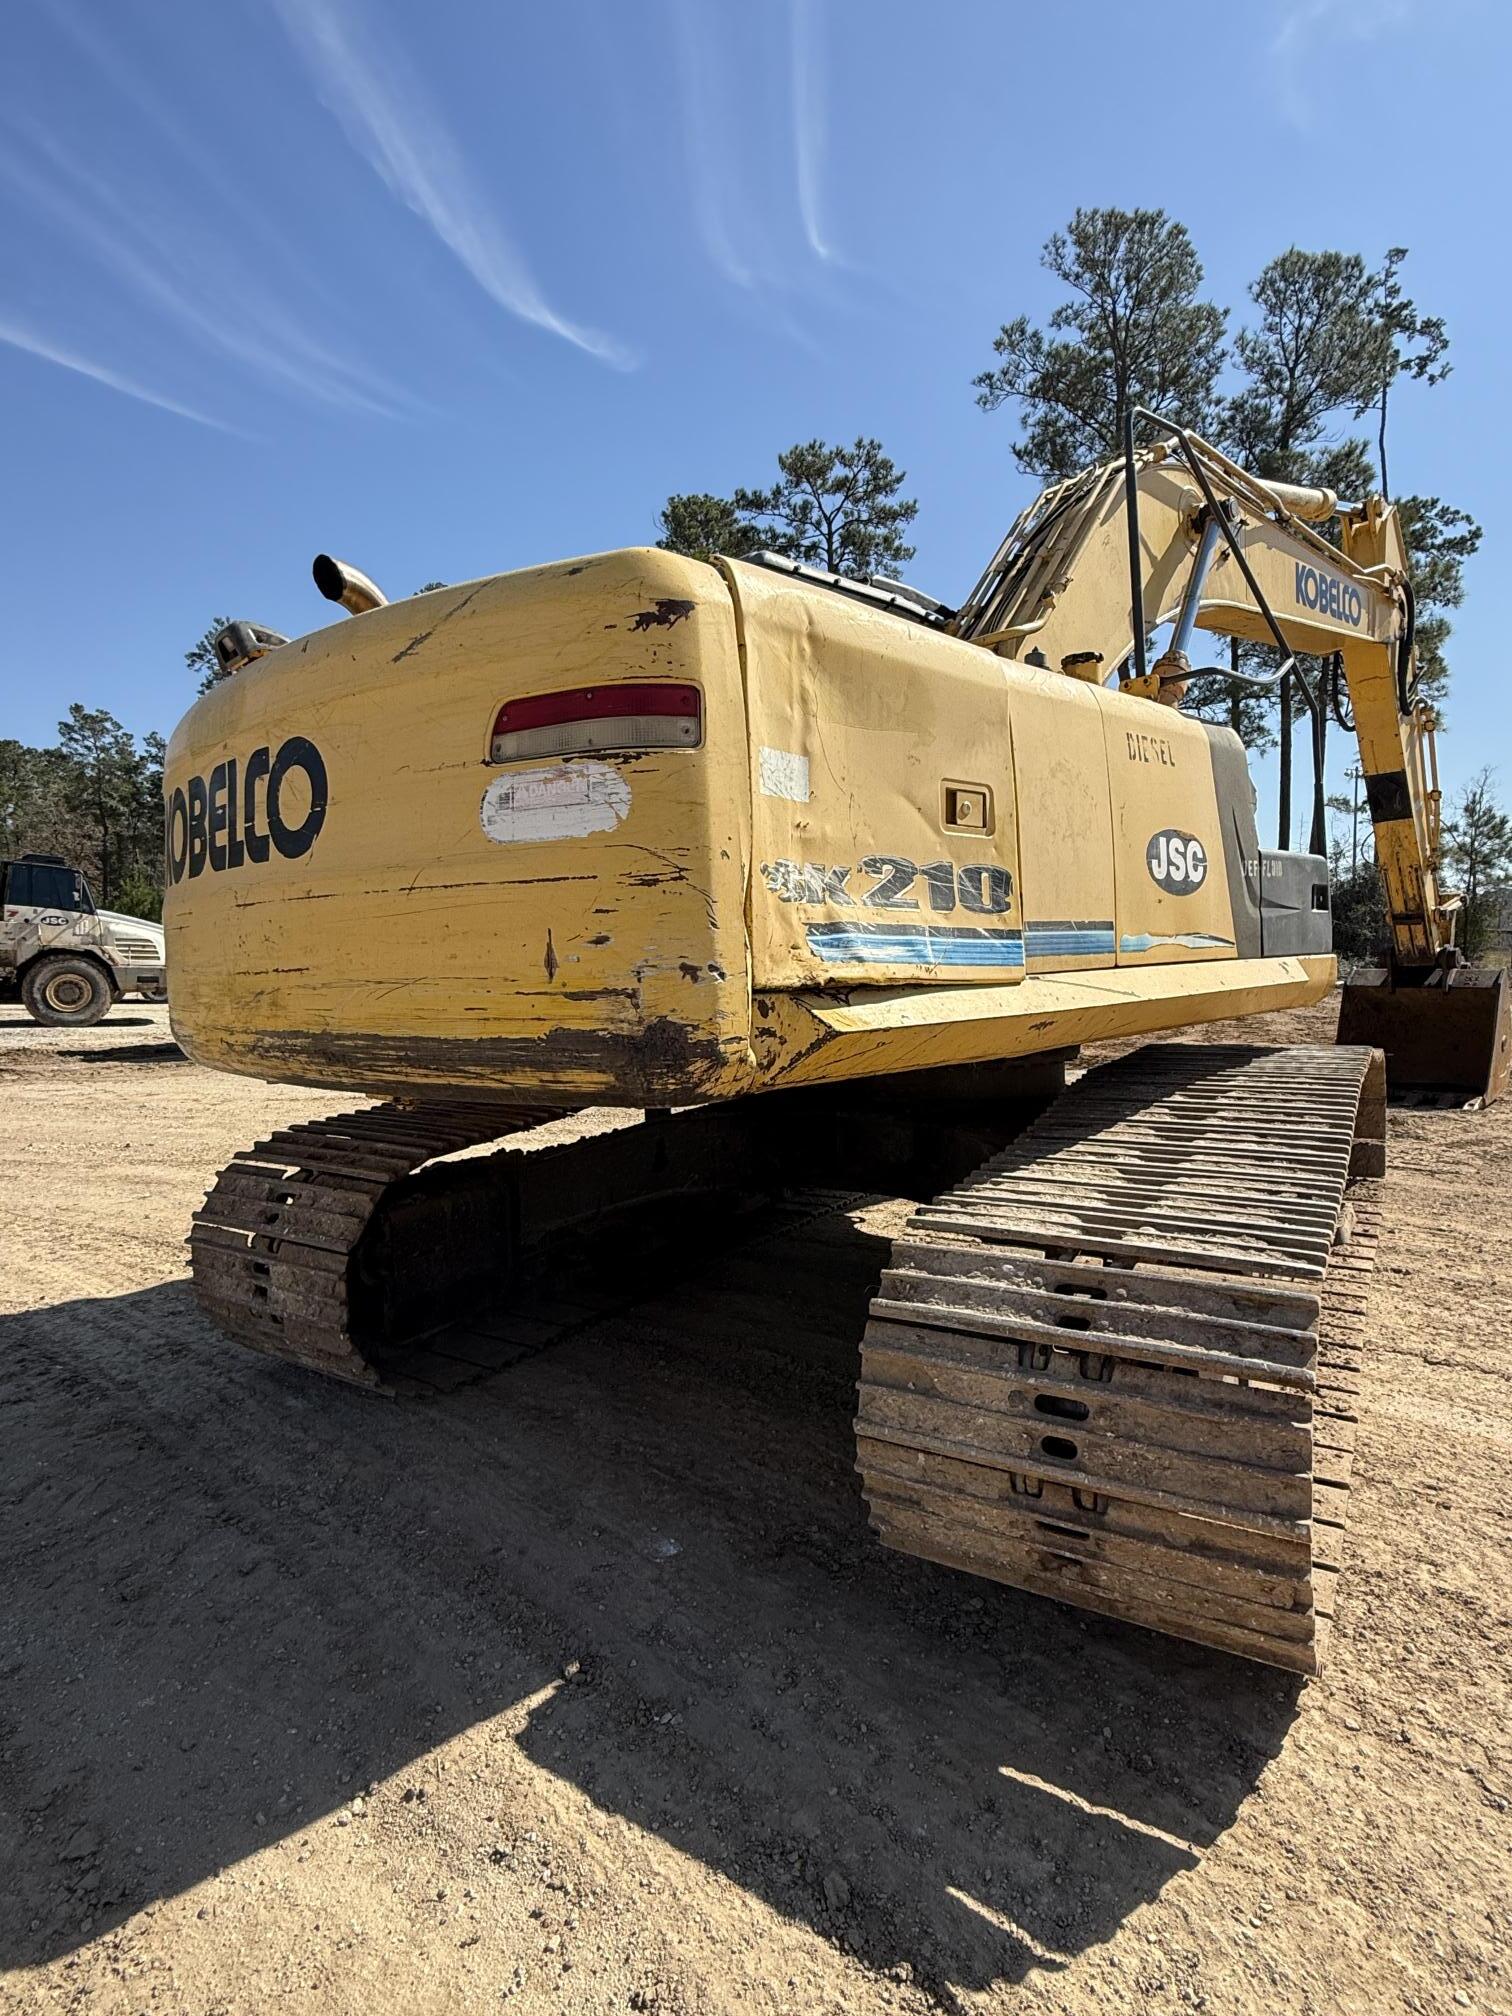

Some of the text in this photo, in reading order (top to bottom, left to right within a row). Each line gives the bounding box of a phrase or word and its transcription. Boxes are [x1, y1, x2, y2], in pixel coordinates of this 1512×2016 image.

[1296, 562, 1360, 627] KOBELCO
[1126, 732, 1176, 767] DIESEL
[1151, 836, 1203, 883] JSC
[42, 917, 67, 925] JSC
